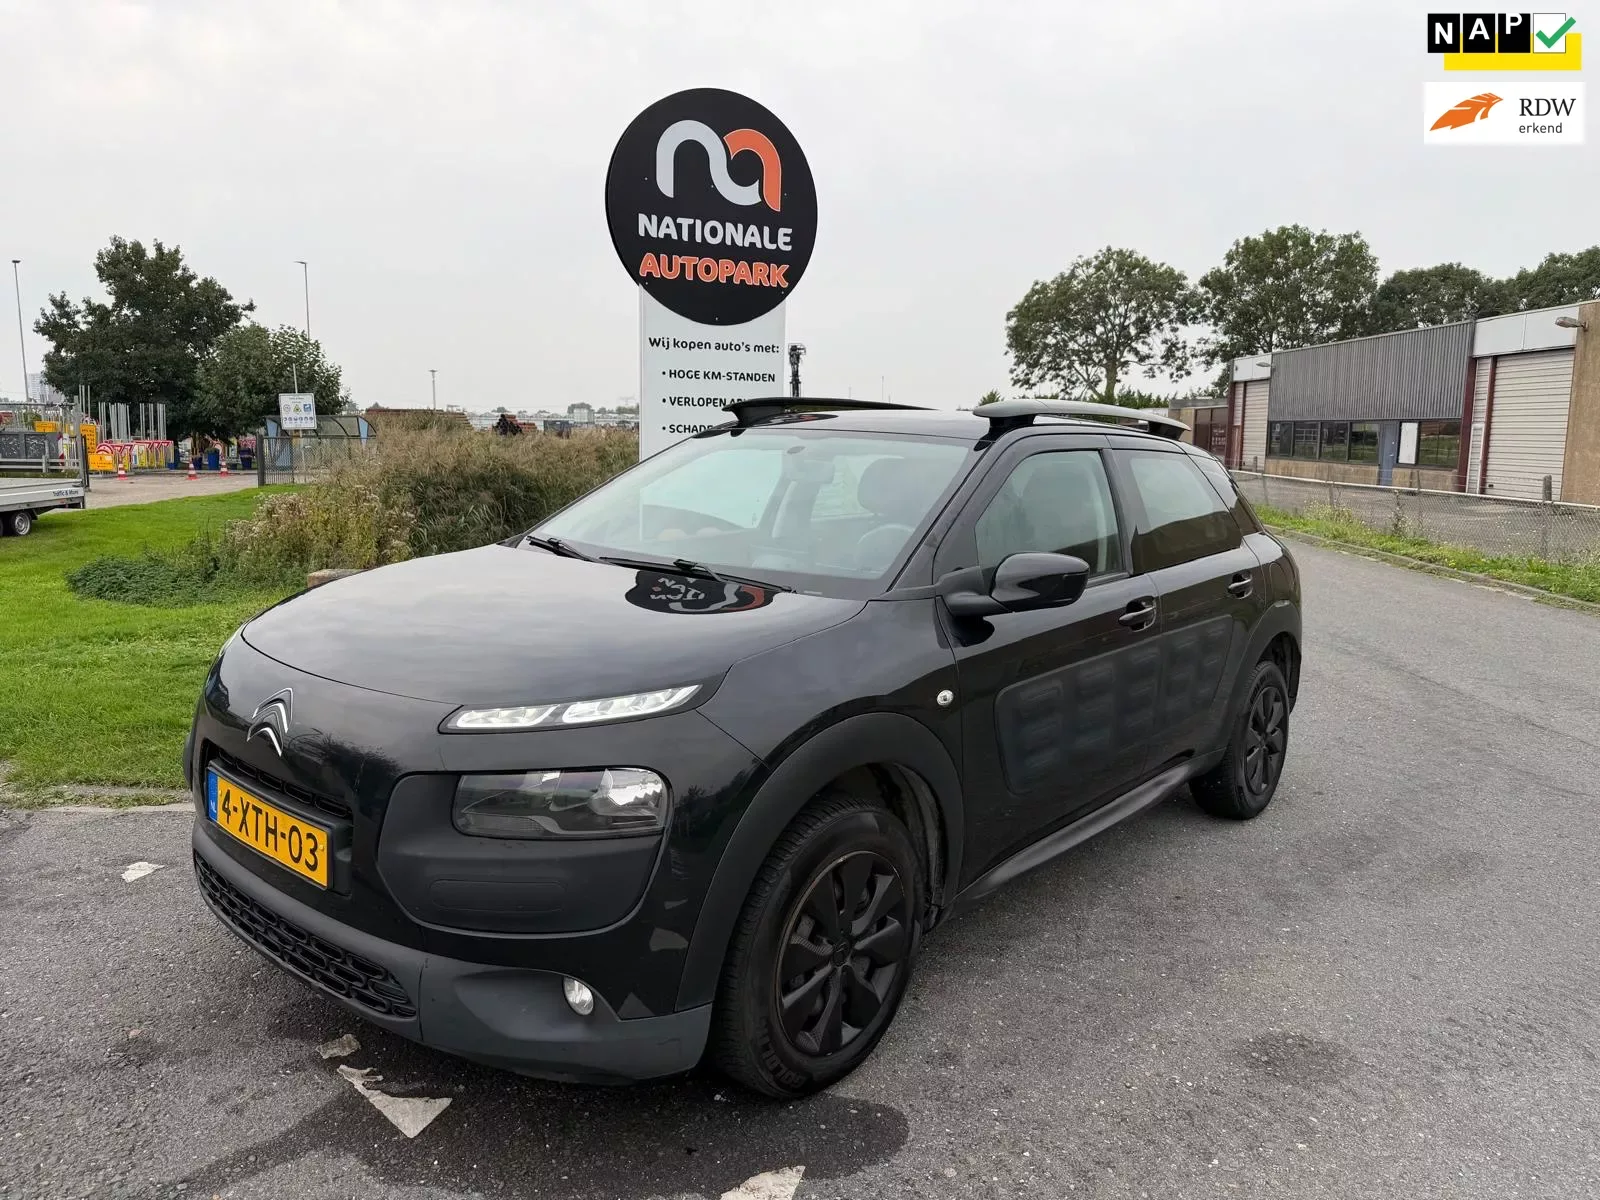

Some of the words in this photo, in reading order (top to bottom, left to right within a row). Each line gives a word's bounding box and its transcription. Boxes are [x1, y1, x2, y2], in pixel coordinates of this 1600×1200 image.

[638, 213, 793, 251] NATIONALE
[639, 252, 790, 288] AUTOPARK
[648, 337, 670, 350] Wij
[673, 338, 711, 351] kopen
[714, 341, 751, 352] auto's
[753, 343, 780, 353] met:
[669, 369, 700, 380] HOGE
[703, 371, 776, 382] KM-STANDEN
[669, 396, 727, 408] VERLOPEN
[221, 788, 319, 872] 4-XTH-03
